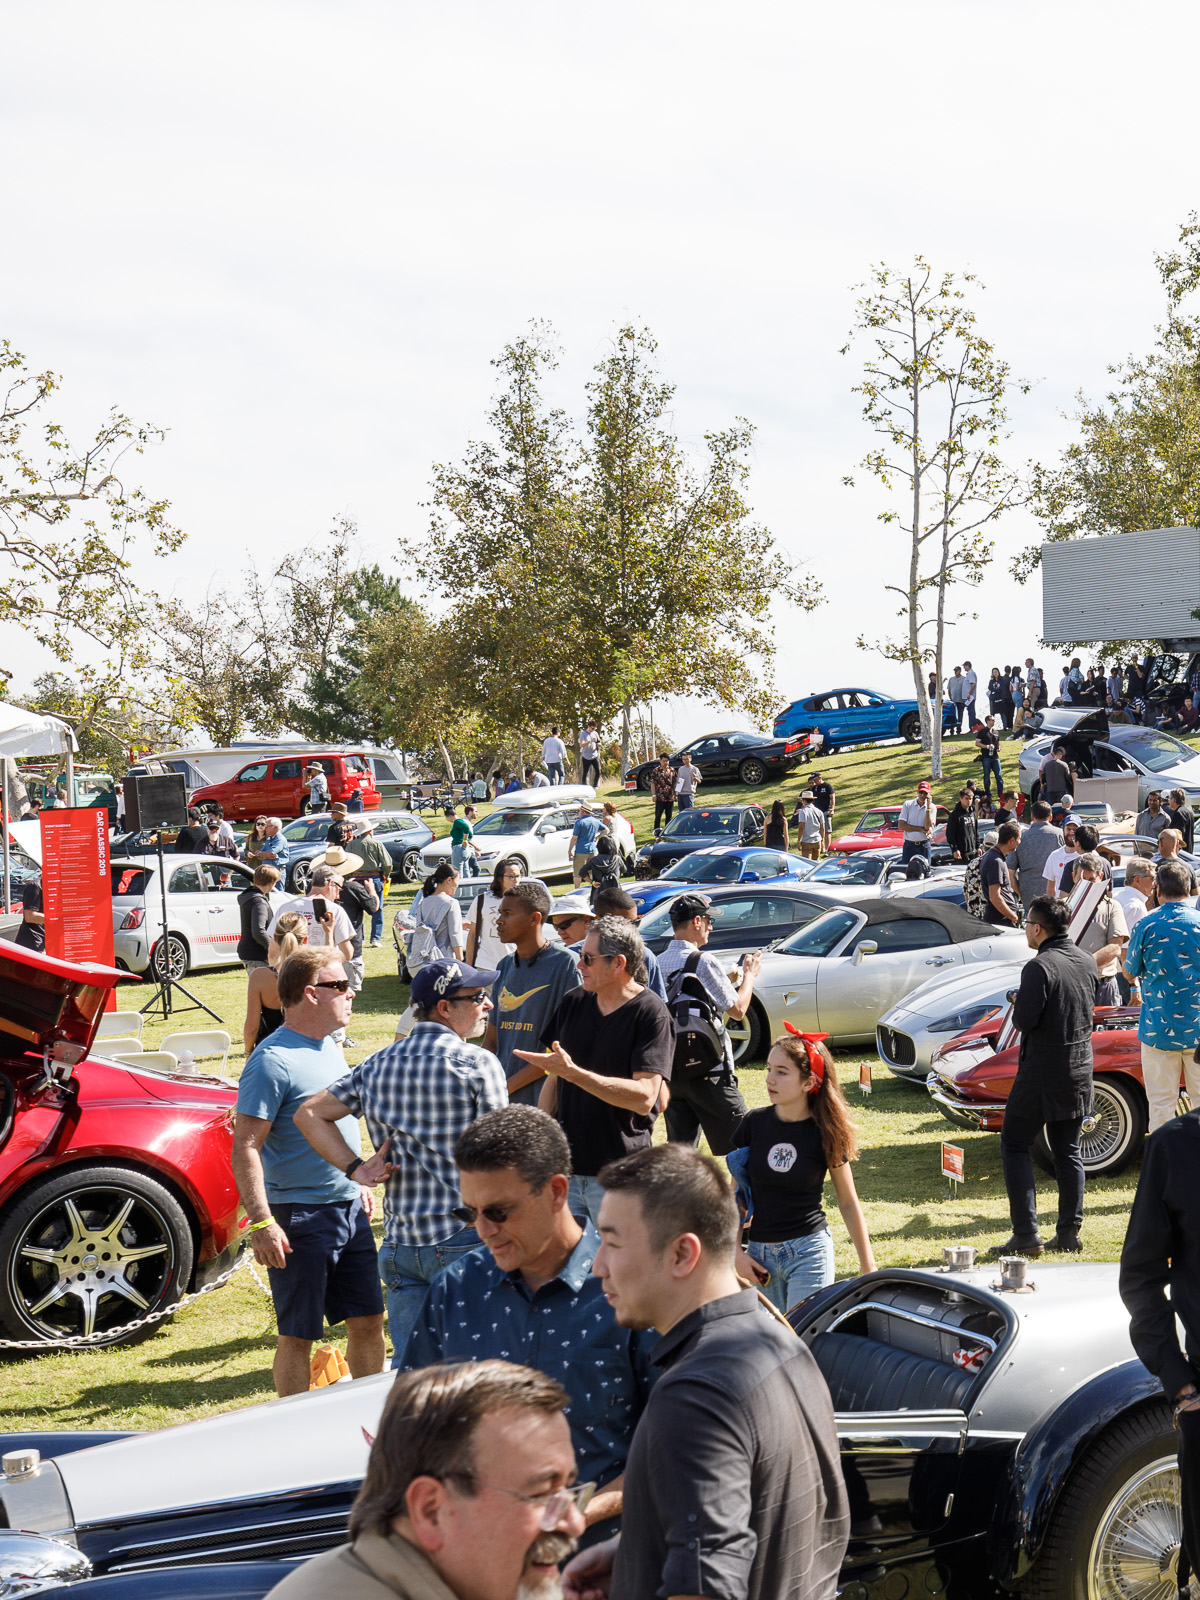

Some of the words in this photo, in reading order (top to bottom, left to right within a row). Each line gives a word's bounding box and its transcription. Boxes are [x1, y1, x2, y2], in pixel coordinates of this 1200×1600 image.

[96, 811, 104, 827] CAR
[97, 827, 106, 859] CLASSIC
[98, 859, 107, 877] 2018
[500, 1021, 516, 1030] JUST
[523, 1022, 534, 1032] IT!
